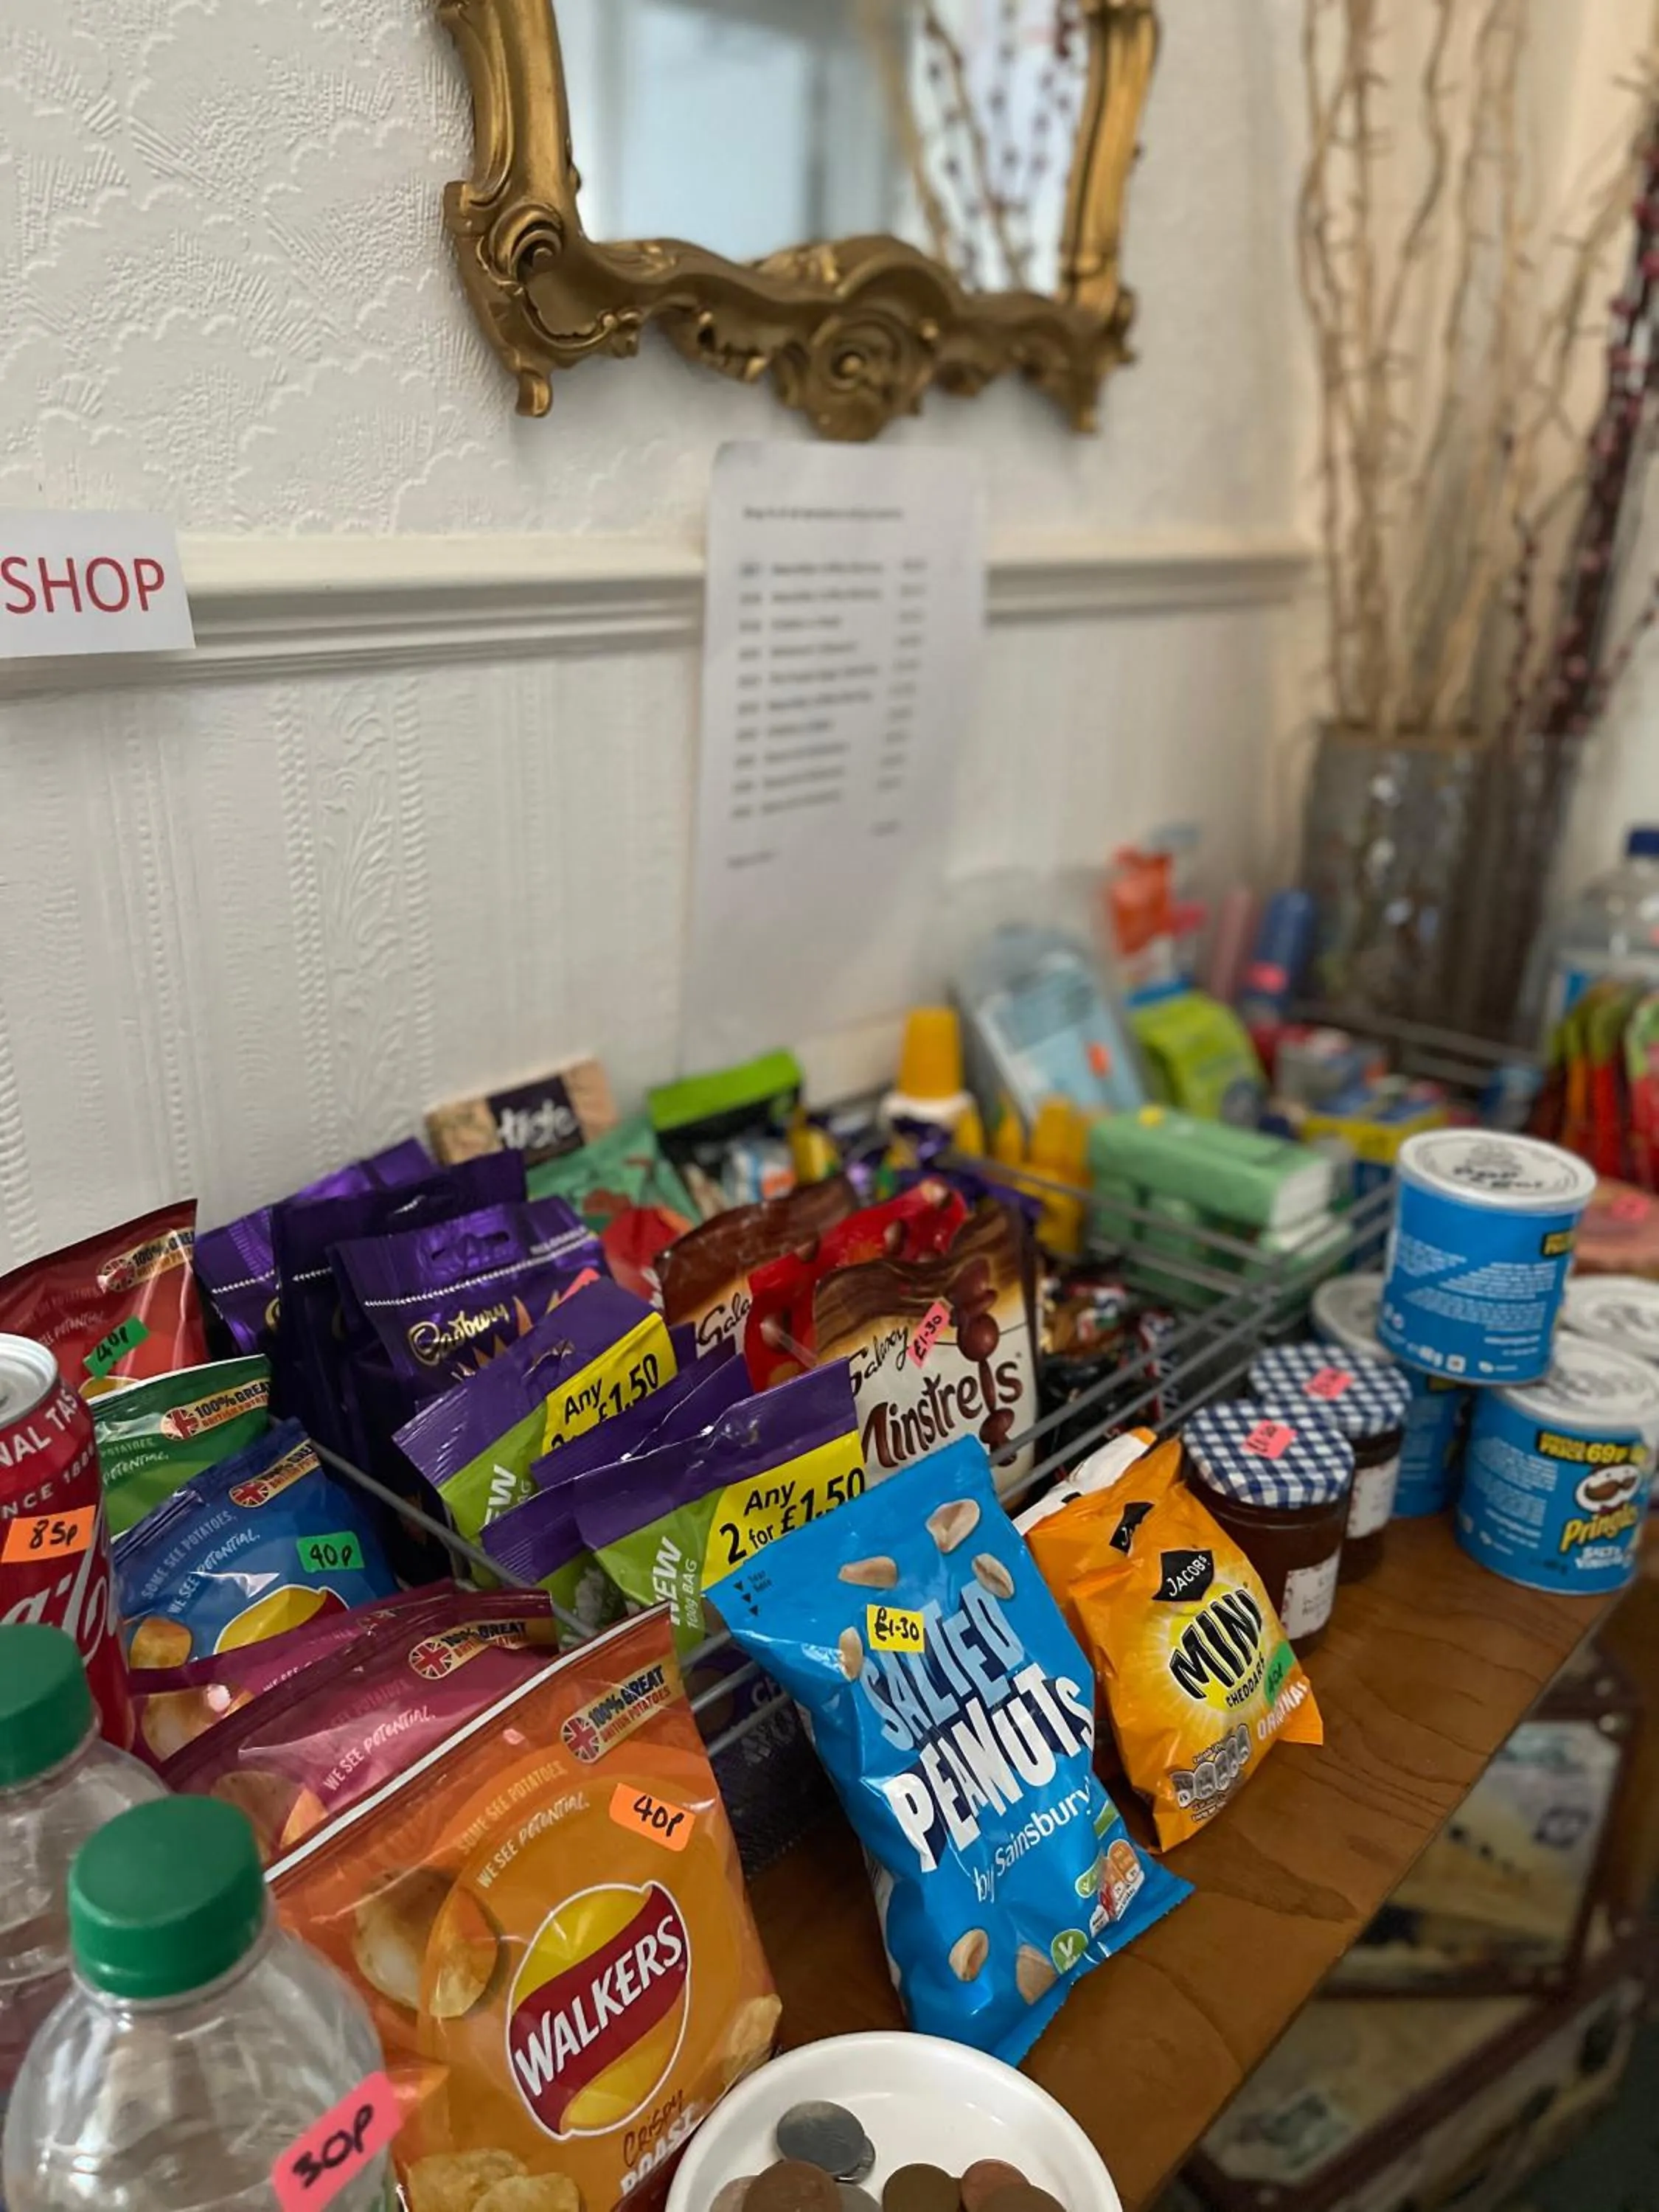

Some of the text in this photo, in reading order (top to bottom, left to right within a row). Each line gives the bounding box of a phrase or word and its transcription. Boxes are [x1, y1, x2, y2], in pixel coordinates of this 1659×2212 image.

[1, 557, 164, 613] SHOP
[408, 1303, 510, 1366] Cadbury
[195, 1394, 237, 1419] 100%
[564, 1378, 602, 1425] Any
[719, 1467, 866, 1565] 2 for £1.50
[742, 1481, 796, 1517] Any
[167, 1595, 187, 1615] WE
[178, 1576, 201, 1600] SEE
[681, 1559, 698, 1595] BAG
[859, 1580, 1025, 1752] SALTED
[1168, 1588, 1262, 1700] MINI
[619, 1664, 665, 1705] GREAT
[323, 1767, 345, 1791] WE
[340, 1747, 365, 1773] SEE
[885, 1662, 1094, 1874] PEANUTS
[485, 1798, 509, 1820] SEE
[476, 1865, 498, 1889] WE
[493, 1840, 518, 1868] SEE
[973, 1865, 995, 1904] by
[515, 1915, 683, 2098] WALKERS
